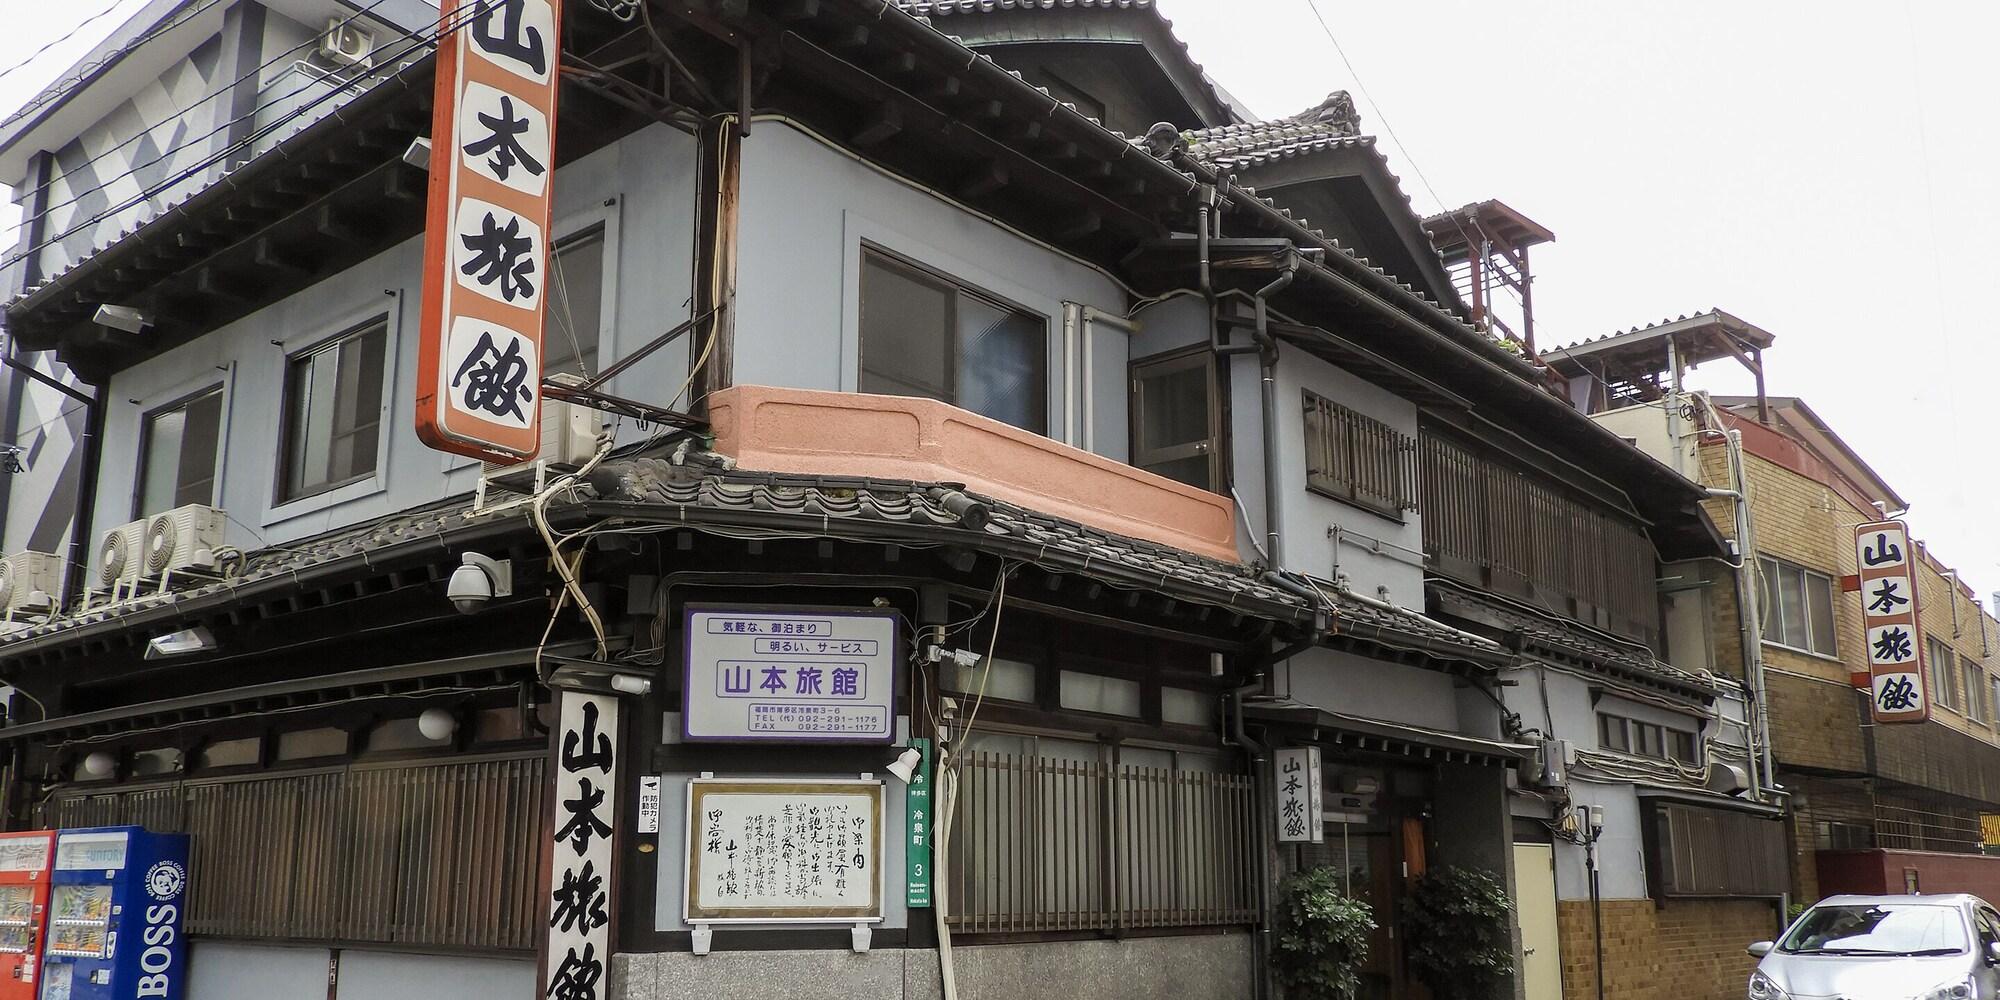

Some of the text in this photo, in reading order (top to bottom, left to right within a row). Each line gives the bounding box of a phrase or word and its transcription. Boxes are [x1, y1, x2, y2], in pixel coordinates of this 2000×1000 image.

[723, 621, 817, 634] 気軽な、御泊まり
[770, 641, 863, 653] 明るい、サービス
[724, 665, 859, 696] 山本旅館
[798, 715, 877, 723] 092-291-1176
[798, 723, 877, 731] 092-291-1177
[913, 774, 924, 785] 冷
[649, 795, 658, 832] 防犯カメラ
[913, 810, 924, 846] 冷泉町
[914, 864, 923, 876] 3
[137, 904, 177, 999] BOSS
